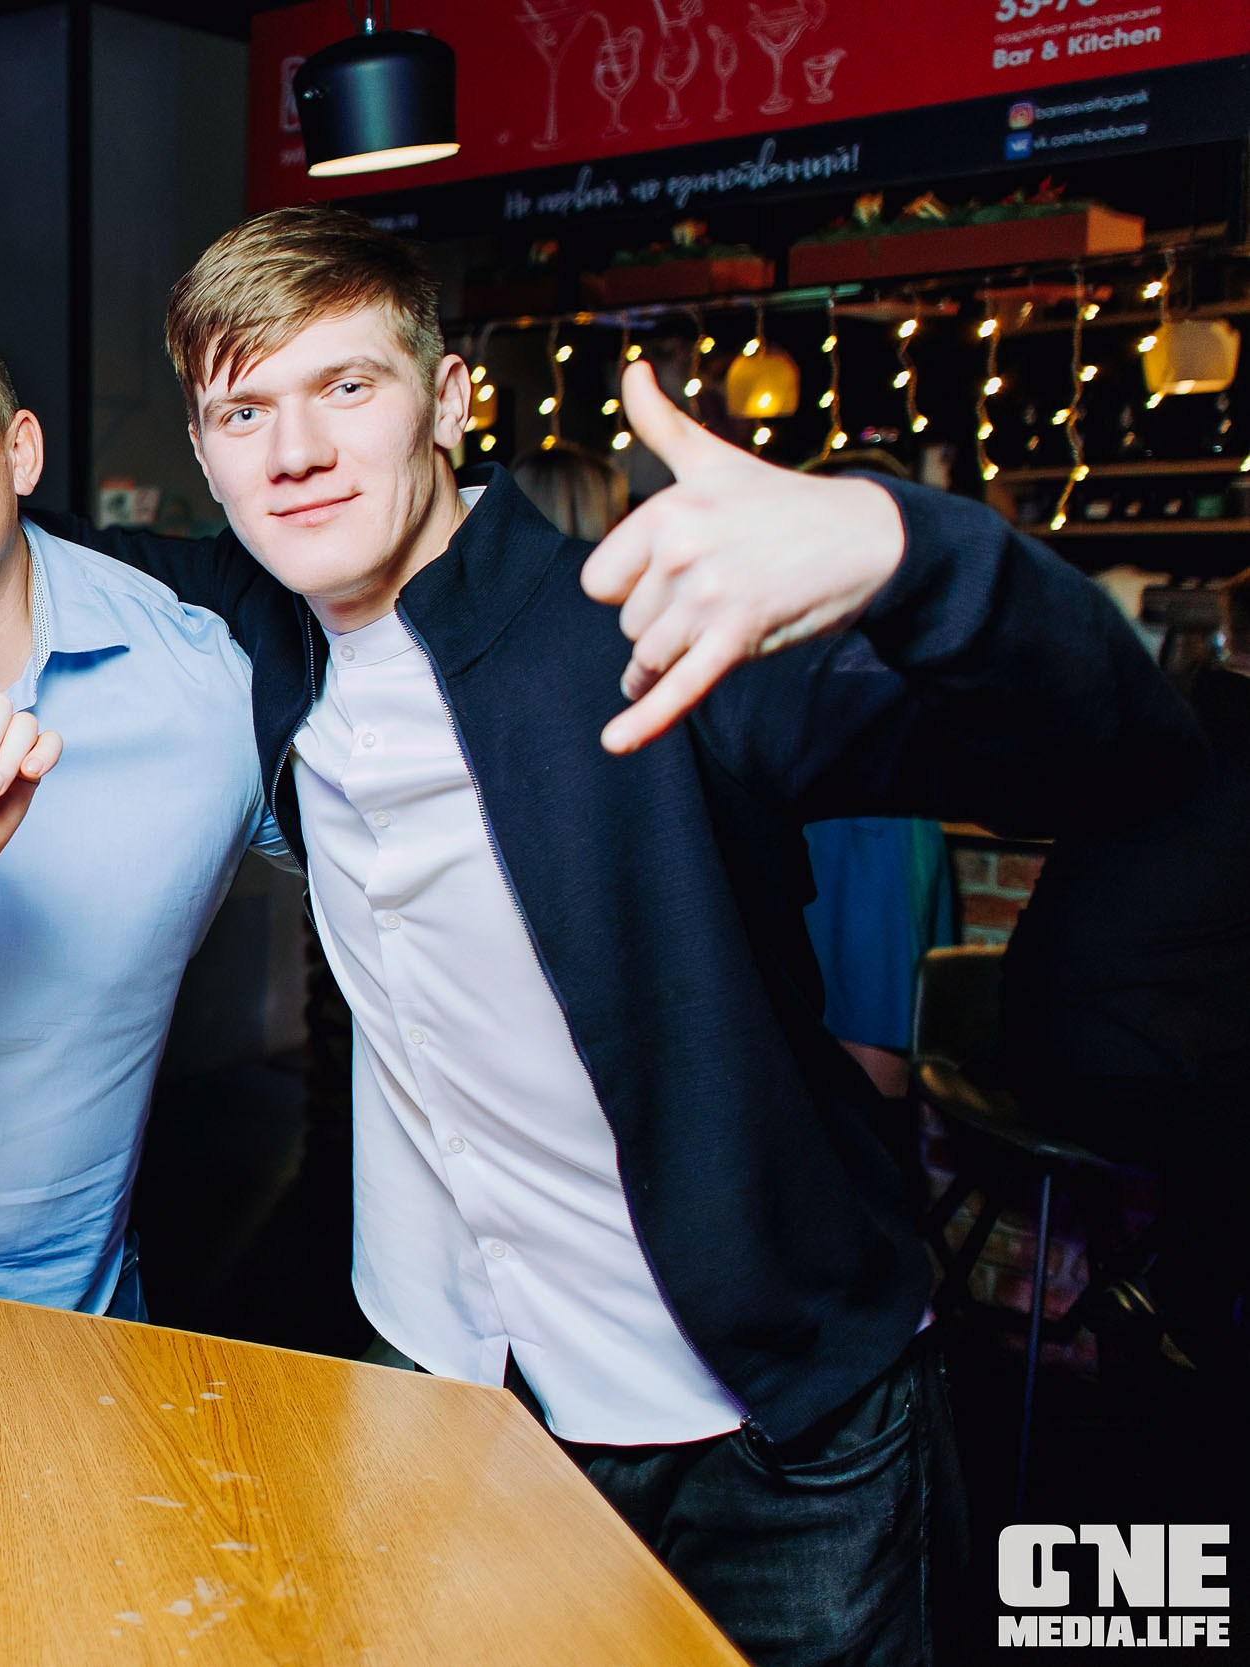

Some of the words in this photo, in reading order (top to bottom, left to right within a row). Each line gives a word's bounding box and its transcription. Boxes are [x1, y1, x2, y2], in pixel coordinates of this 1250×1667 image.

[992, 48, 1033, 69] Bar
[1041, 40, 1059, 60] &
[1067, 26, 1161, 56] Kitchen
[503, 190, 531, 220] Не
[630, 177, 659, 199] но
